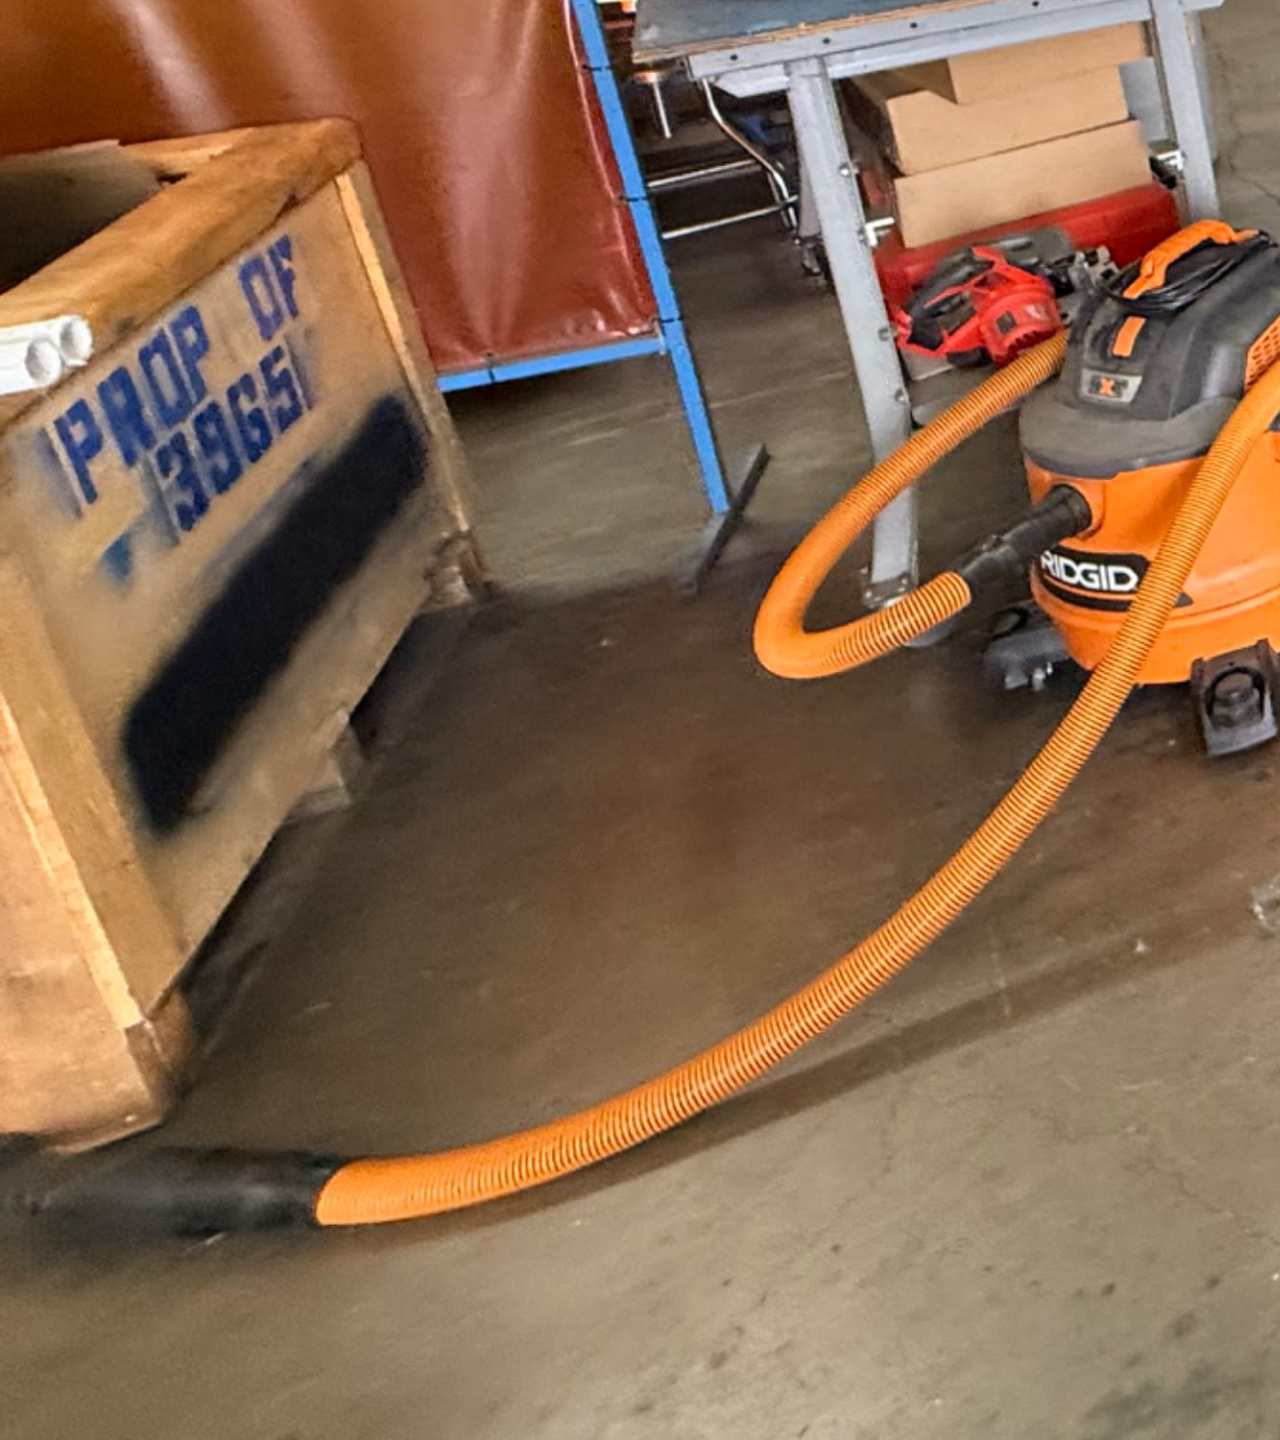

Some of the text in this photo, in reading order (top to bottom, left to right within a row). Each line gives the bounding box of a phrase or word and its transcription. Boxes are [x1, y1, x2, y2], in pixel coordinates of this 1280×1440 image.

[54, 234, 299, 505] PROP OF
[1040, 550, 1139, 591] RIDGID
